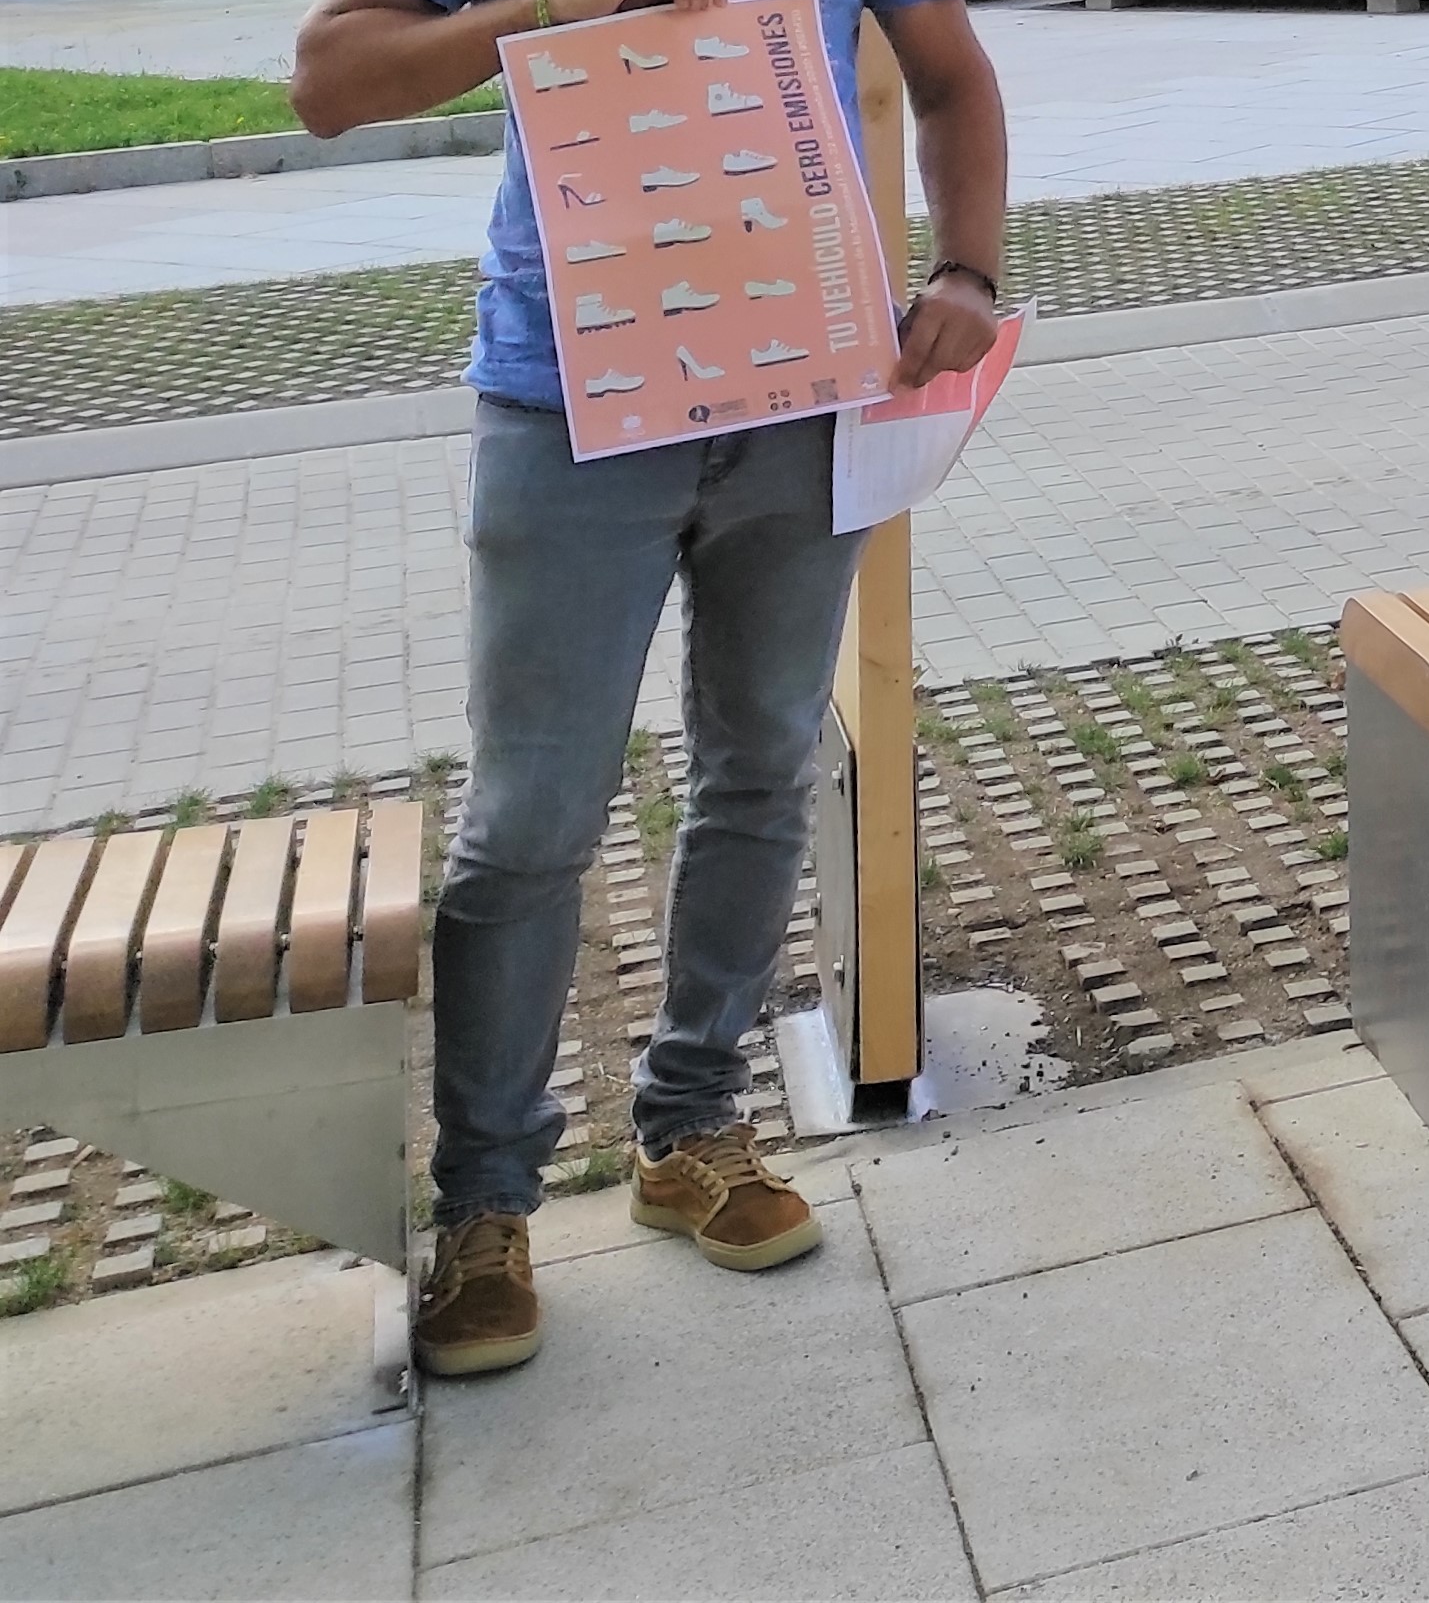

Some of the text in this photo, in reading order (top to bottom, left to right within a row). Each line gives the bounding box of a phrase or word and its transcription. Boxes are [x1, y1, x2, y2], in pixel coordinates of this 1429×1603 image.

[757, 12, 859, 354] TU VEHÍCULO CERO EMISIONES
